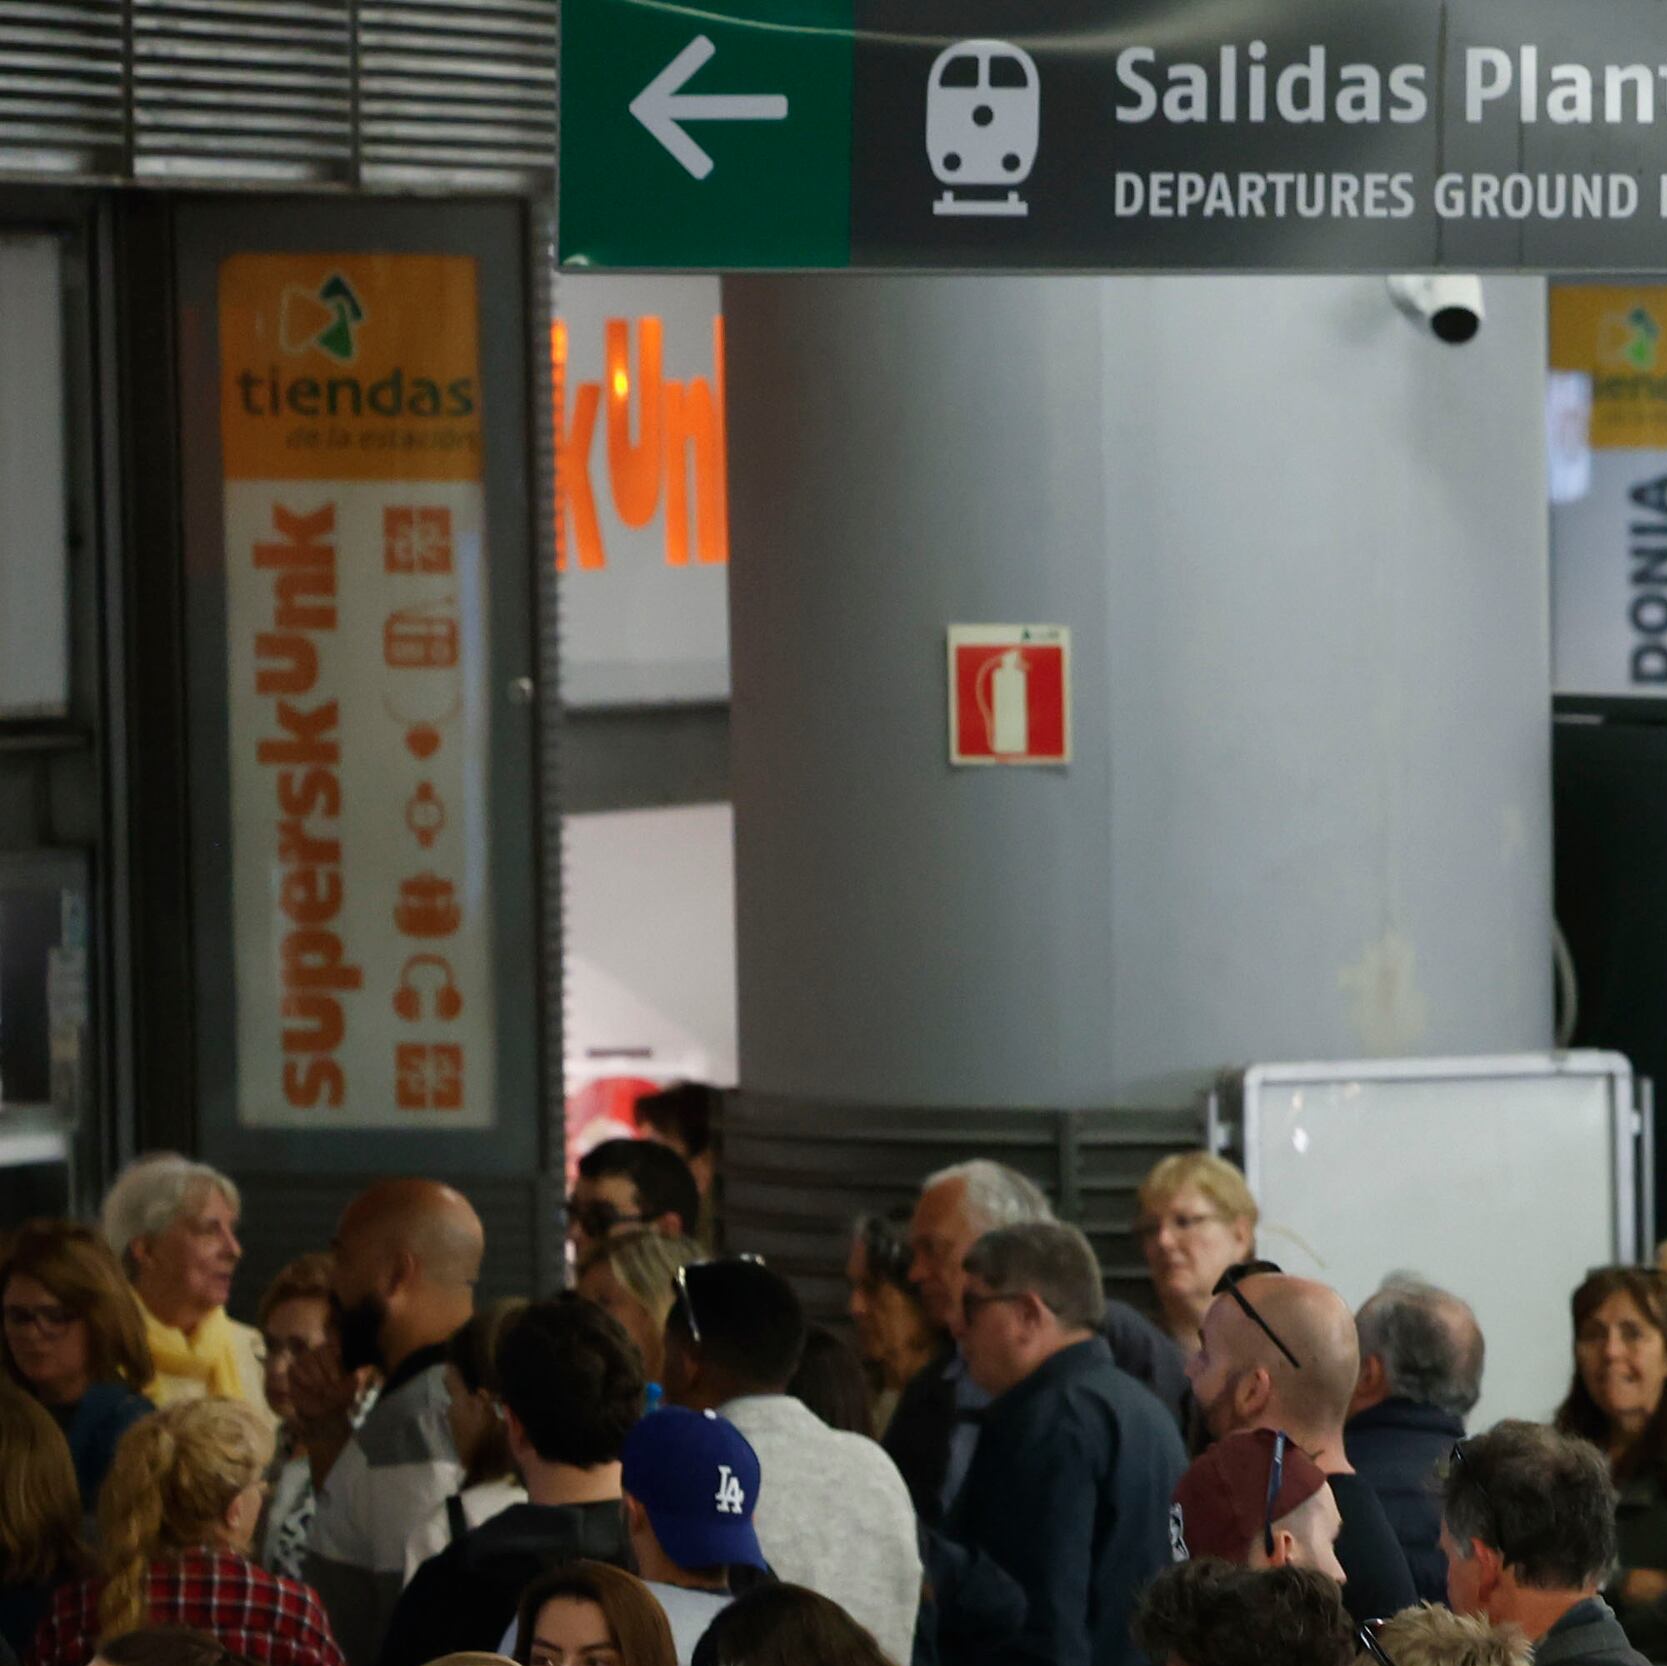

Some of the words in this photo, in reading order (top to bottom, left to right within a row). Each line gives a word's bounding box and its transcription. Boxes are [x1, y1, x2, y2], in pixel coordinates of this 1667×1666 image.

[1114, 40, 1427, 125] Salidas
[1114, 172, 1415, 220] DEPARTURES
[1434, 172, 1637, 220] GROUND
[236, 366, 475, 416] tiendas
[715, 1465, 745, 1514] LA
